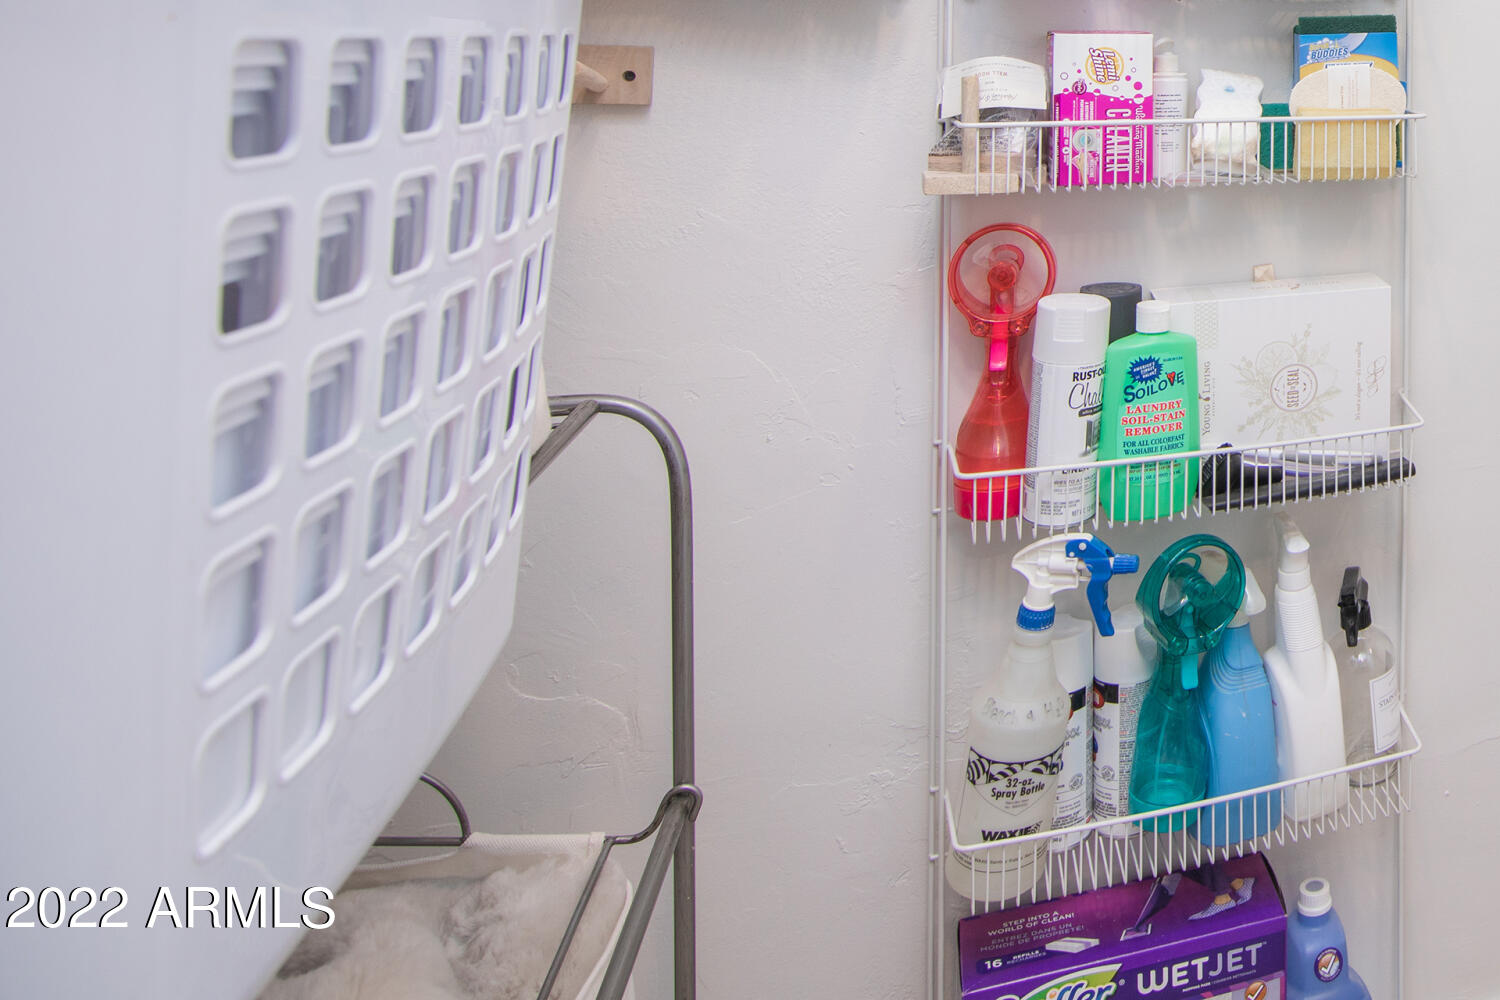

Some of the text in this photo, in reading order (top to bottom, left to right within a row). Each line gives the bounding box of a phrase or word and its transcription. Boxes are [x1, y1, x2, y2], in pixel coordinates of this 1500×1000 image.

[1311, 47, 1349, 60] BUDDIES
[1089, 48, 1106, 83] Shine
[1104, 50, 1120, 81] Lemi
[1124, 370, 1184, 403] SOILOVE
[1287, 368, 1299, 407] SEED SEAL
[1126, 399, 1183, 415] LAUNDRY
[1202, 361, 1211, 436] YOUNG LIVING
[1121, 408, 1186, 426] SOIL-STAIN
[1125, 421, 1183, 437] REMOVER
[1122, 434, 1185, 448] FOR ALL COLORFAST
[1124, 441, 1185, 455] WASHABLE FABRICS
[991, 783, 1045, 800] Spray Bottle
[1005, 778, 1035, 788] 32-oz.
[981, 825, 1033, 842] WAXIE
[988, 924, 1024, 936] WORLD
[1041, 912, 1075, 924] CLEAN!
[1002, 919, 1025, 928] STEP
[1028, 912, 1050, 923] INTO
[992, 932, 1028, 944] ENTREZ
[1031, 926, 1057, 936] DANS
[980, 941, 1015, 952] MONDE
[1012, 950, 1040, 959] REFILLS
[985, 959, 1003, 970] 16
[1137, 942, 1264, 995] WETJET
